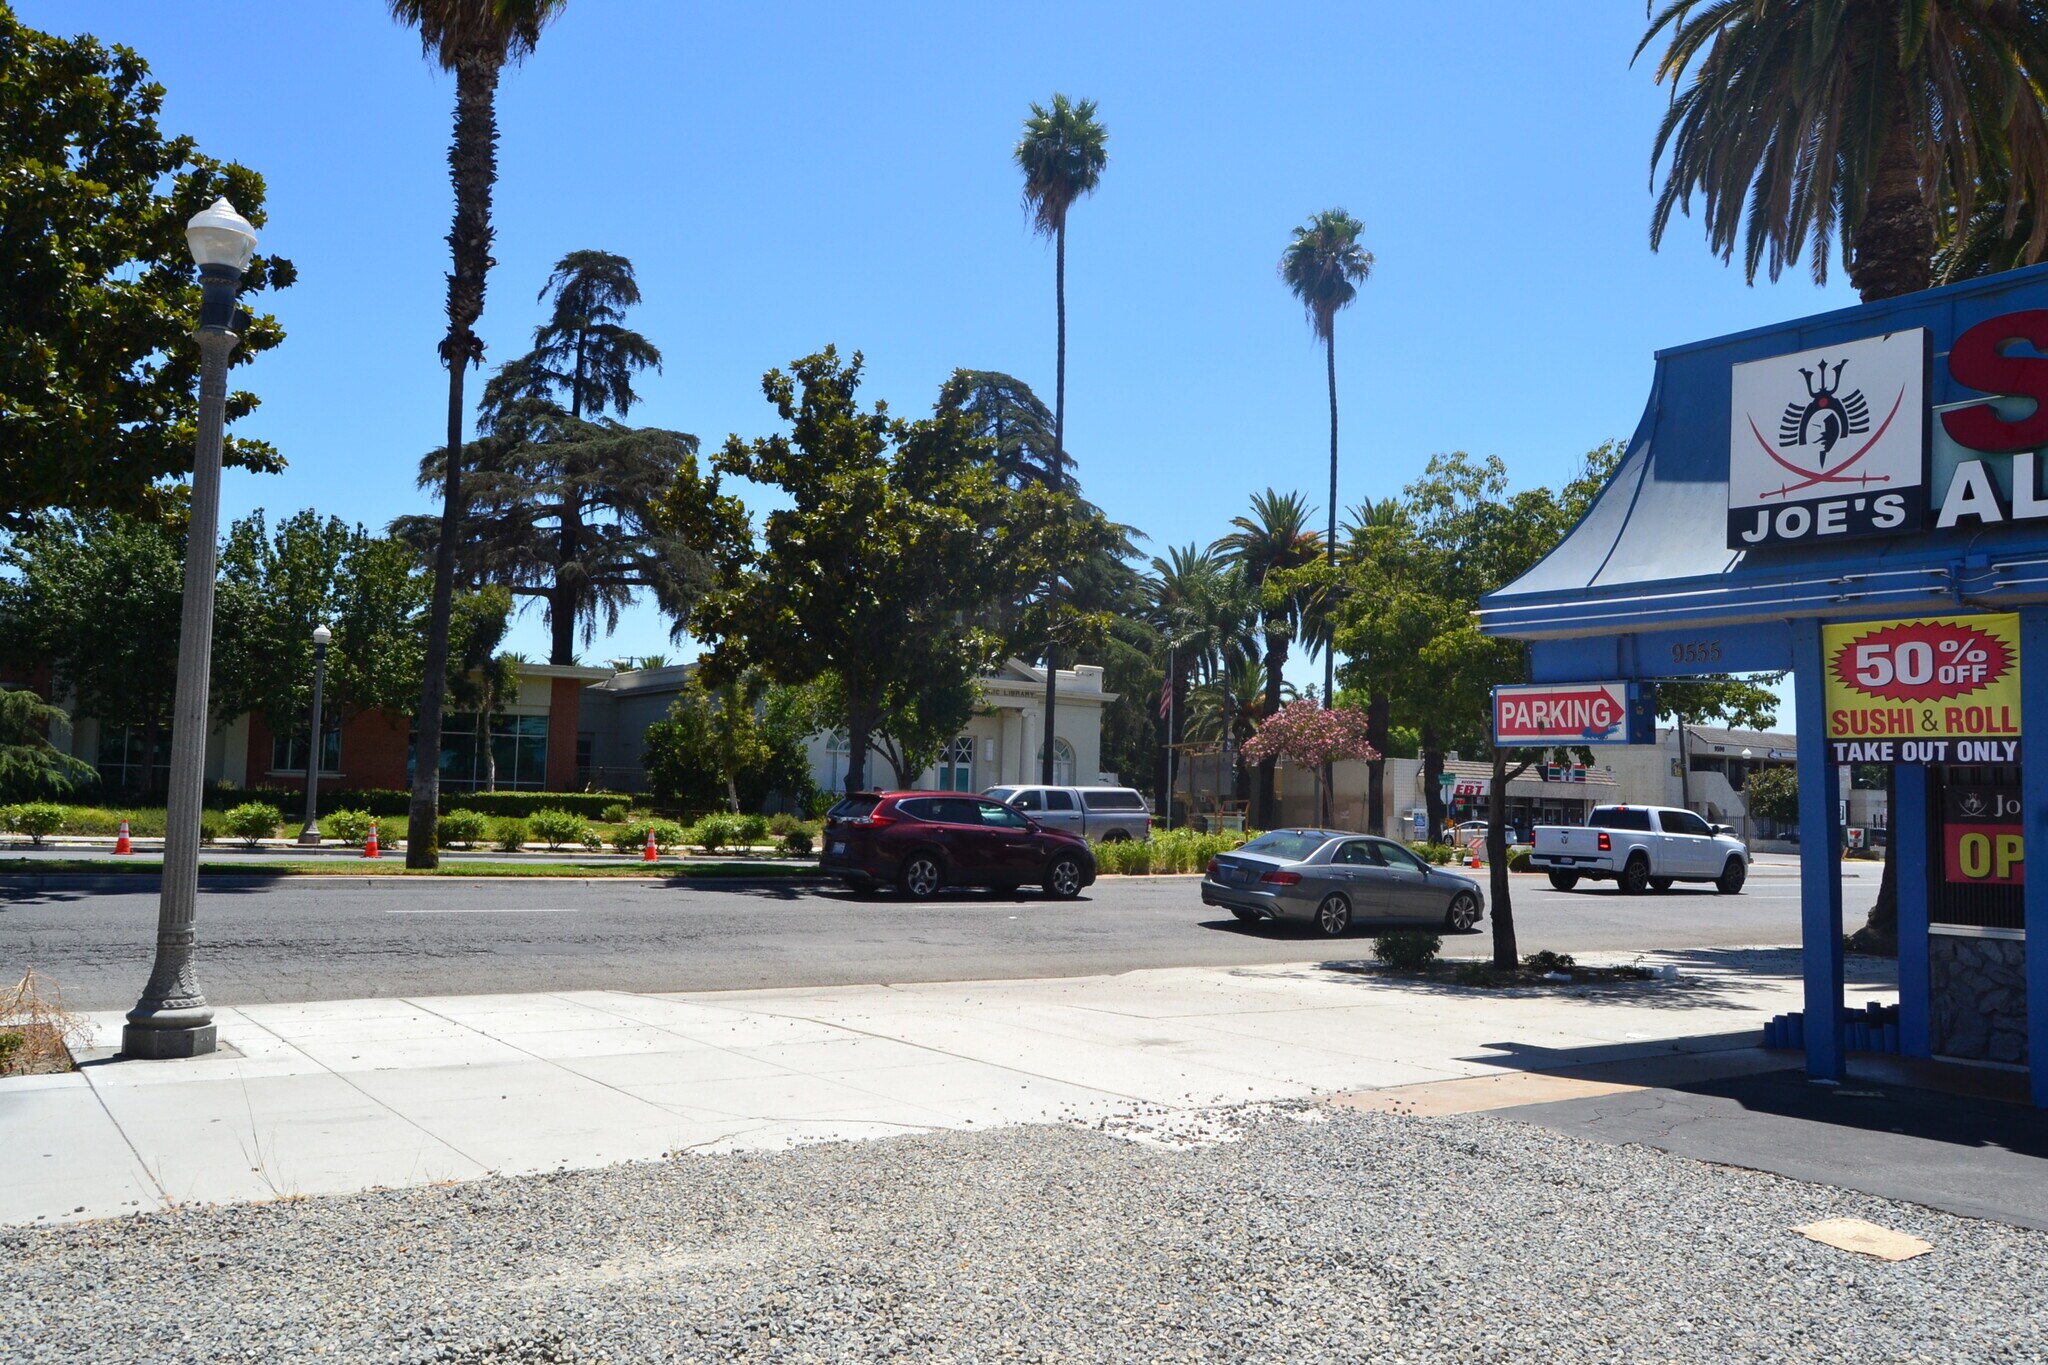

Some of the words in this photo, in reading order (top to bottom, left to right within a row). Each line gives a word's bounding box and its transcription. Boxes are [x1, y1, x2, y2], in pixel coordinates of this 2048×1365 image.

[1741, 494, 1906, 543] JOE'S
[1671, 640, 1722, 664] 9555
[1938, 664, 1987, 684] OFF
[1501, 698, 1611, 729] PARKING
[1832, 708, 1914, 736] SUSHI
[1921, 709, 1939, 732] &
[1945, 706, 2018, 734] ROLL
[1833, 741, 1893, 762] TAKE
[1902, 741, 1949, 762] OUT
[1957, 740, 2018, 762] ONLY
[1455, 784, 1484, 796] EBT
